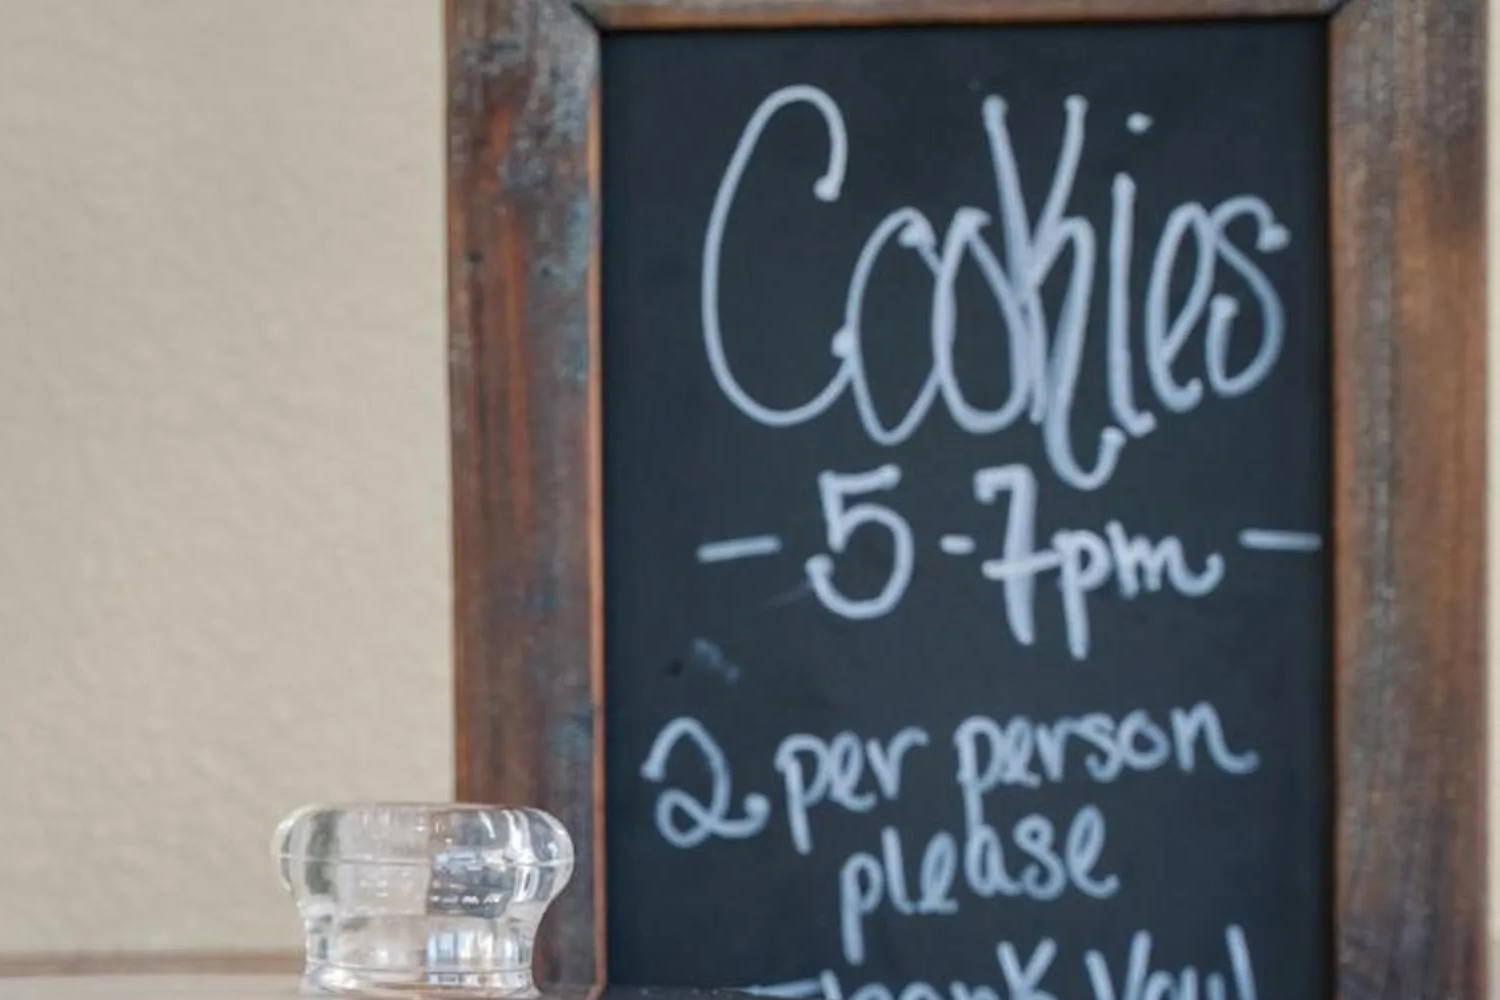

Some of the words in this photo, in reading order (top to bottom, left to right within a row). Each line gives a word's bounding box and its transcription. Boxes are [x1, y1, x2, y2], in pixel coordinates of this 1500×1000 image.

[703, 84, 1289, 489] Cookies
[775, 732, 929, 854] per
[955, 702, 1259, 840] person
[840, 804, 1119, 965] please
